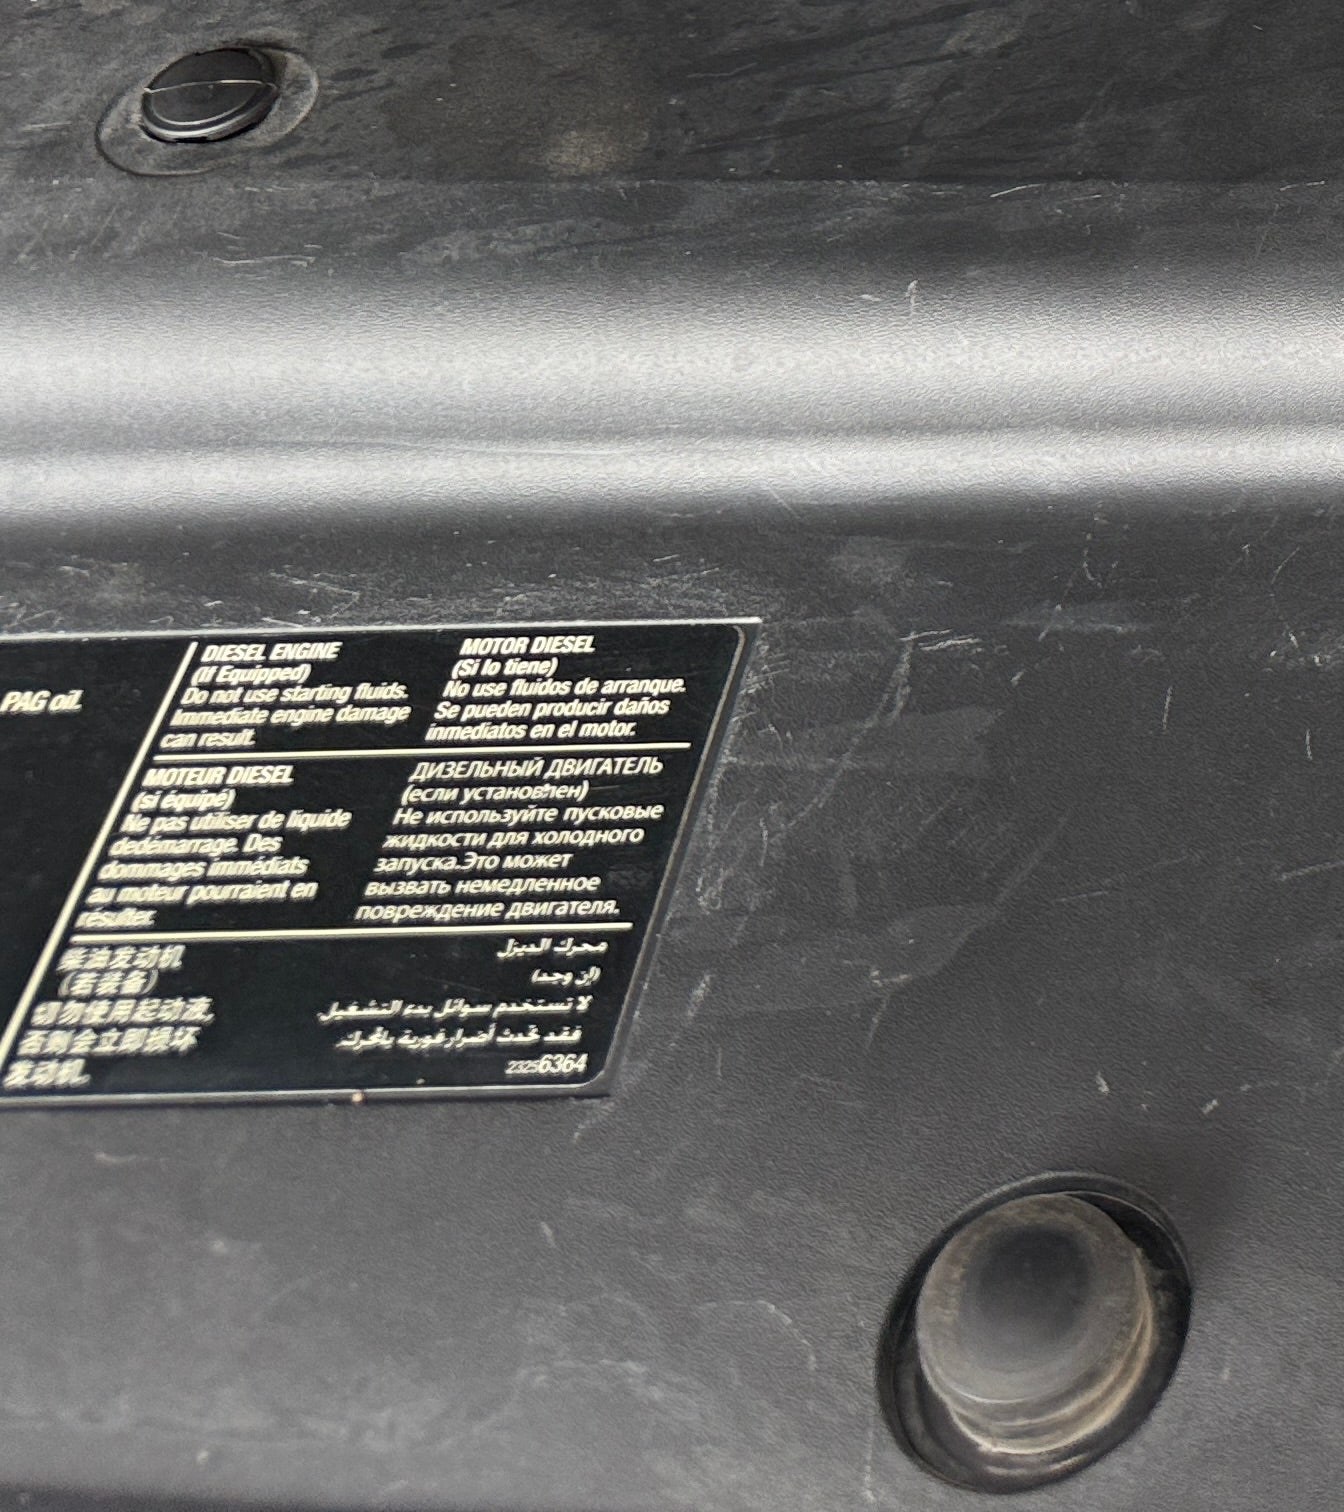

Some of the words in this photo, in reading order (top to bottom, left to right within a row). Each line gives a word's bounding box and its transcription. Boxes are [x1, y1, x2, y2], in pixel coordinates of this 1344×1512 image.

[200, 644, 266, 663] DIESEL
[270, 642, 342, 661] ENGINE
[460, 638, 527, 655] MOTOR
[530, 635, 595, 653] DIESEL
[192, 666, 216, 687] (If
[218, 664, 311, 686] Equipped)
[452, 659, 479, 679] (Si
[481, 658, 501, 676] lo
[504, 657, 558, 678] tiene)
[181, 688, 206, 706] Do
[209, 687, 241, 704] not
[244, 688, 278, 704] use
[280, 685, 352, 705] starting
[354, 683, 408, 701] fluids.
[442, 680, 470, 697] No
[472, 682, 506, 696] use
[509, 678, 572, 695] fluidos
[574, 678, 599, 694] de
[601, 678, 686, 697] arranque.
[0, 691, 47, 713] PAG
[48, 690, 83, 712] oil.
[434, 701, 459, 719] Se
[461, 700, 531, 721] pueden
[532, 698, 612, 719] producir
[614, 696, 670, 715] daños
[170, 707, 269, 727] Immediate
[271, 708, 334, 726] engine
[336, 704, 411, 724] damage
[161, 731, 195, 748] can
[198, 727, 256, 747] result.
[425, 723, 526, 741] inmediatos
[529, 724, 553, 738] en
[556, 721, 578, 738] el
[578, 721, 636, 738] motor.
[142, 767, 226, 787] MOTEUR
[225, 765, 294, 785] DIESEL
[408, 757, 545, 782] ДИЗЕЛЬНЫЙ
[544, 756, 663, 779] ДВИГАТЕЛЬ
[131, 790, 159, 812] (si
[159, 788, 236, 811] équipé)
[401, 784, 457, 805] (если
[459, 780, 589, 805] установлен)
[120, 814, 149, 832] Ne
[151, 816, 189, 835] pas
[189, 812, 258, 831] utiliser
[258, 811, 285, 830] de
[286, 809, 352, 830] liquide
[392, 808, 423, 826] Не
[425, 804, 558, 827] используйте
[562, 804, 664, 825] пусковые
[242, 833, 283, 853] Des
[382, 832, 487, 851] жидкости
[489, 830, 527, 849] для
[531, 828, 645, 847] холодного
[99, 859, 206, 880] dommages
[207, 856, 310, 877] immédiats
[502, 852, 574, 869] может
[86, 887, 116, 904] au
[116, 884, 189, 903] moteur
[186, 881, 289, 905] pourraient
[290, 882, 318, 900] en
[364, 880, 450, 897] вызвать
[454, 876, 601, 896] немедленное
[74, 908, 156, 928] résulter.
[354, 901, 504, 923] повреждение
[504, 899, 620, 920] двигателя.
[496, 938, 552, 959] الديزل
[553, 938, 609, 959] محرك
[492, 997, 573, 1019] تستخدم
[575, 995, 593, 1012] لا
